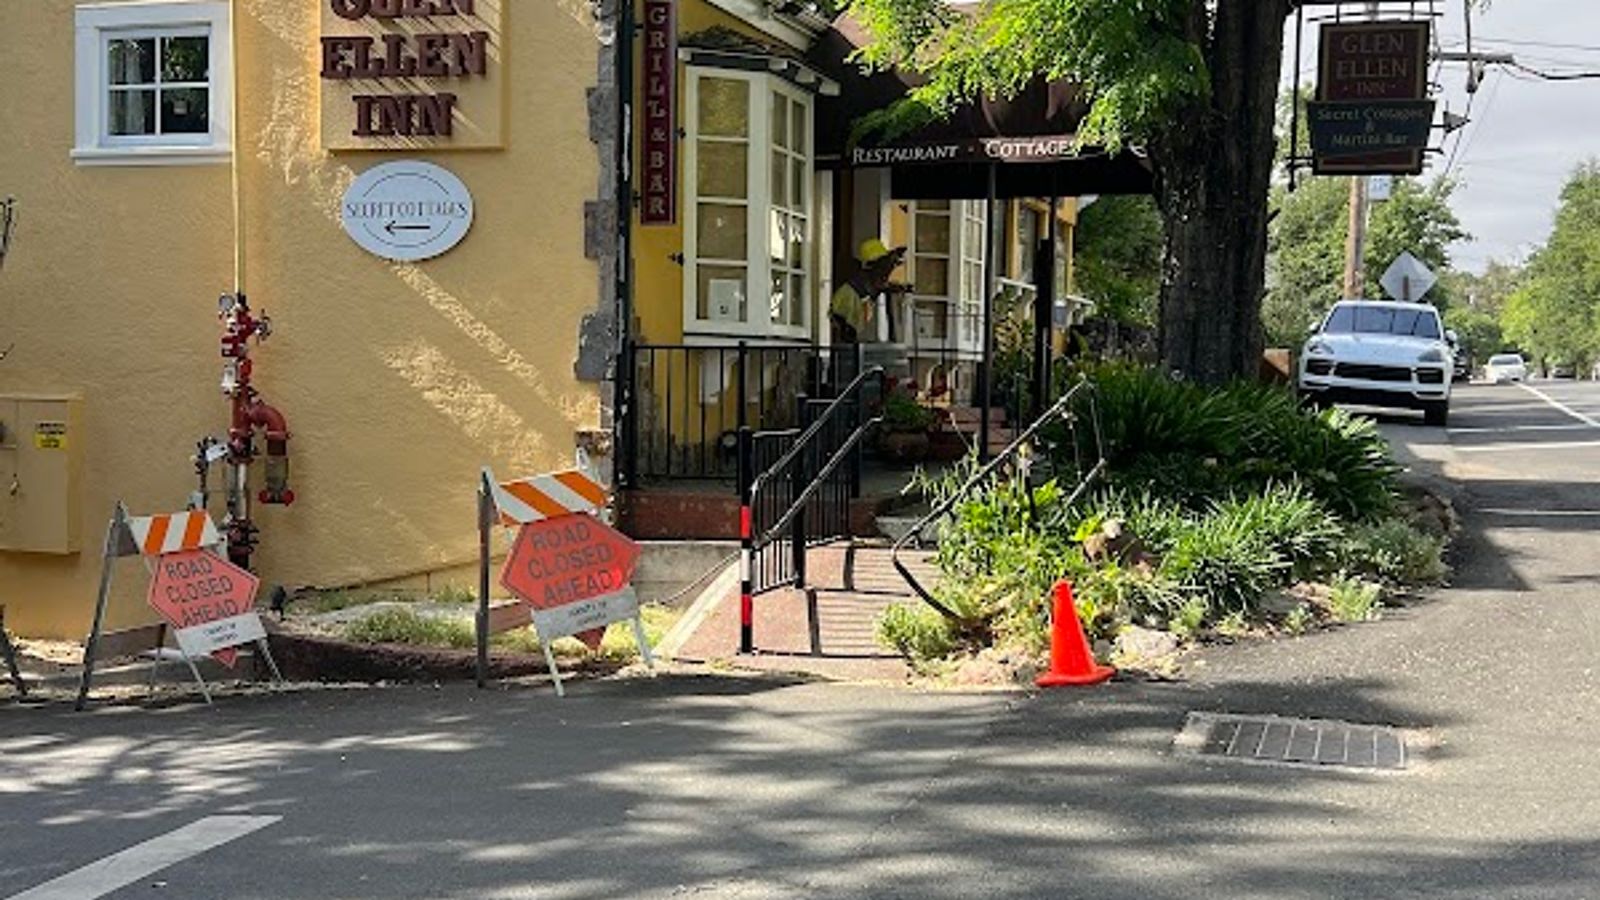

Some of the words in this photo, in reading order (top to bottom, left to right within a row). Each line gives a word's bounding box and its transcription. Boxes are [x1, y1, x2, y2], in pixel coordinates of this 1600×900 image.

[320, 31, 488, 78] ELLEN
[1341, 33, 1404, 54] GLEN
[649, 7, 667, 118] GRILL
[1336, 57, 1408, 79] ELLEN
[1356, 81, 1386, 95] INN
[352, 93, 457, 137] INN
[1317, 107, 1359, 121] Secret
[650, 127, 667, 142] &
[1385, 132, 1409, 145] Bar
[853, 144, 960, 163] RESTAURANT
[649, 151, 667, 214] BAR
[531, 521, 591, 551] ROAD
[165, 556, 213, 582] ROAD
[527, 543, 612, 580] CLOSED
[165, 575, 234, 604] CLOSED
[543, 569, 613, 602] AHEAD
[180, 599, 239, 628] AHEAD
